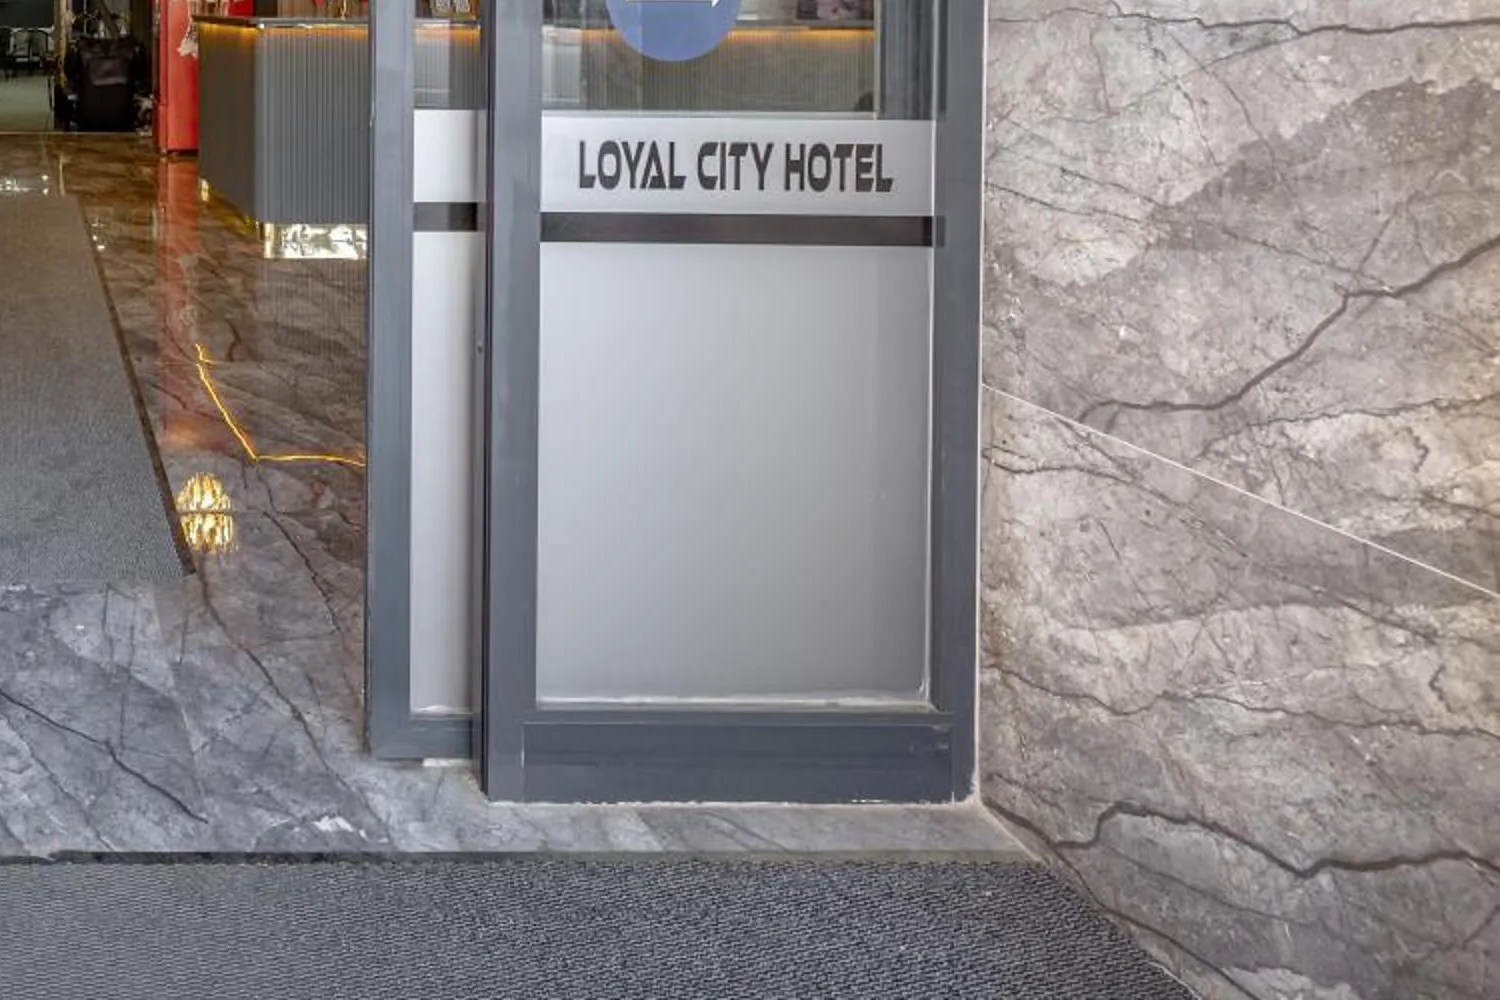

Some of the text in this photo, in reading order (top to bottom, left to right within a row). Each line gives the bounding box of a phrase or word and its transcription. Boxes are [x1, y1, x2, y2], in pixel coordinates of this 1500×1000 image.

[579, 139, 895, 193] LOYAL CITY HOTEL
